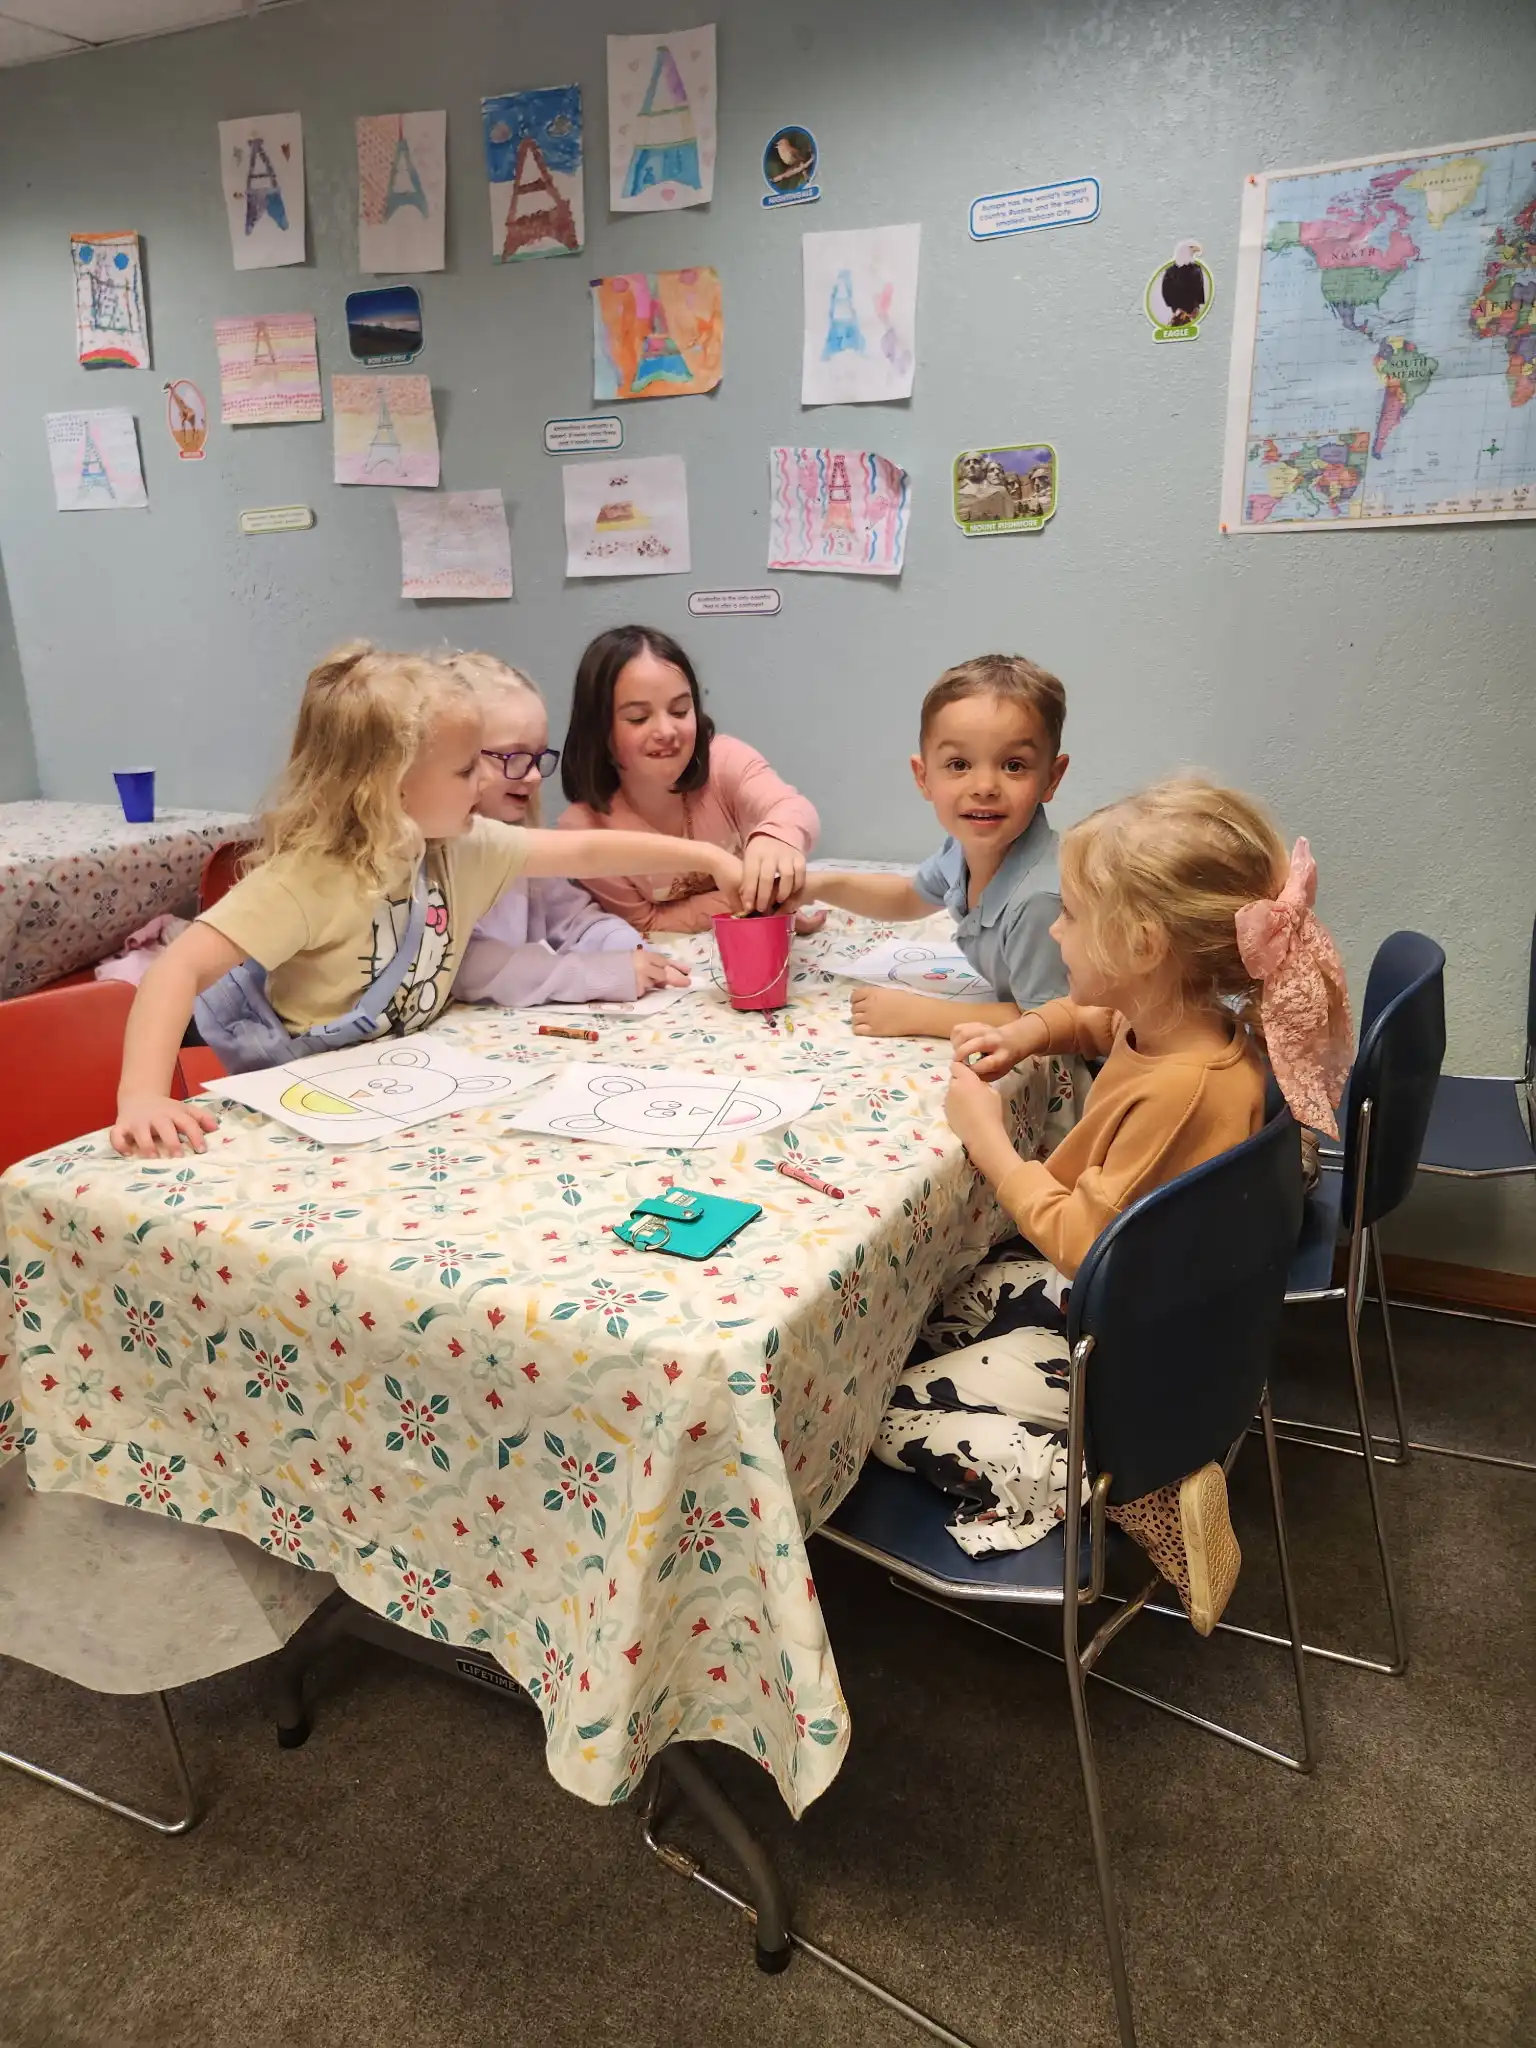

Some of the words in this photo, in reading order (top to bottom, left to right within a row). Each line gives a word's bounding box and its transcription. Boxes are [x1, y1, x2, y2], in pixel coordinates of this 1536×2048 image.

[1163, 328, 1189, 338] EAGLE
[1391, 356, 1428, 368] SOUTH
[970, 522, 996, 532] MOUNT
[998, 520, 1038, 530] RUSHMORE
[462, 1663, 516, 1691] LIFETIME
